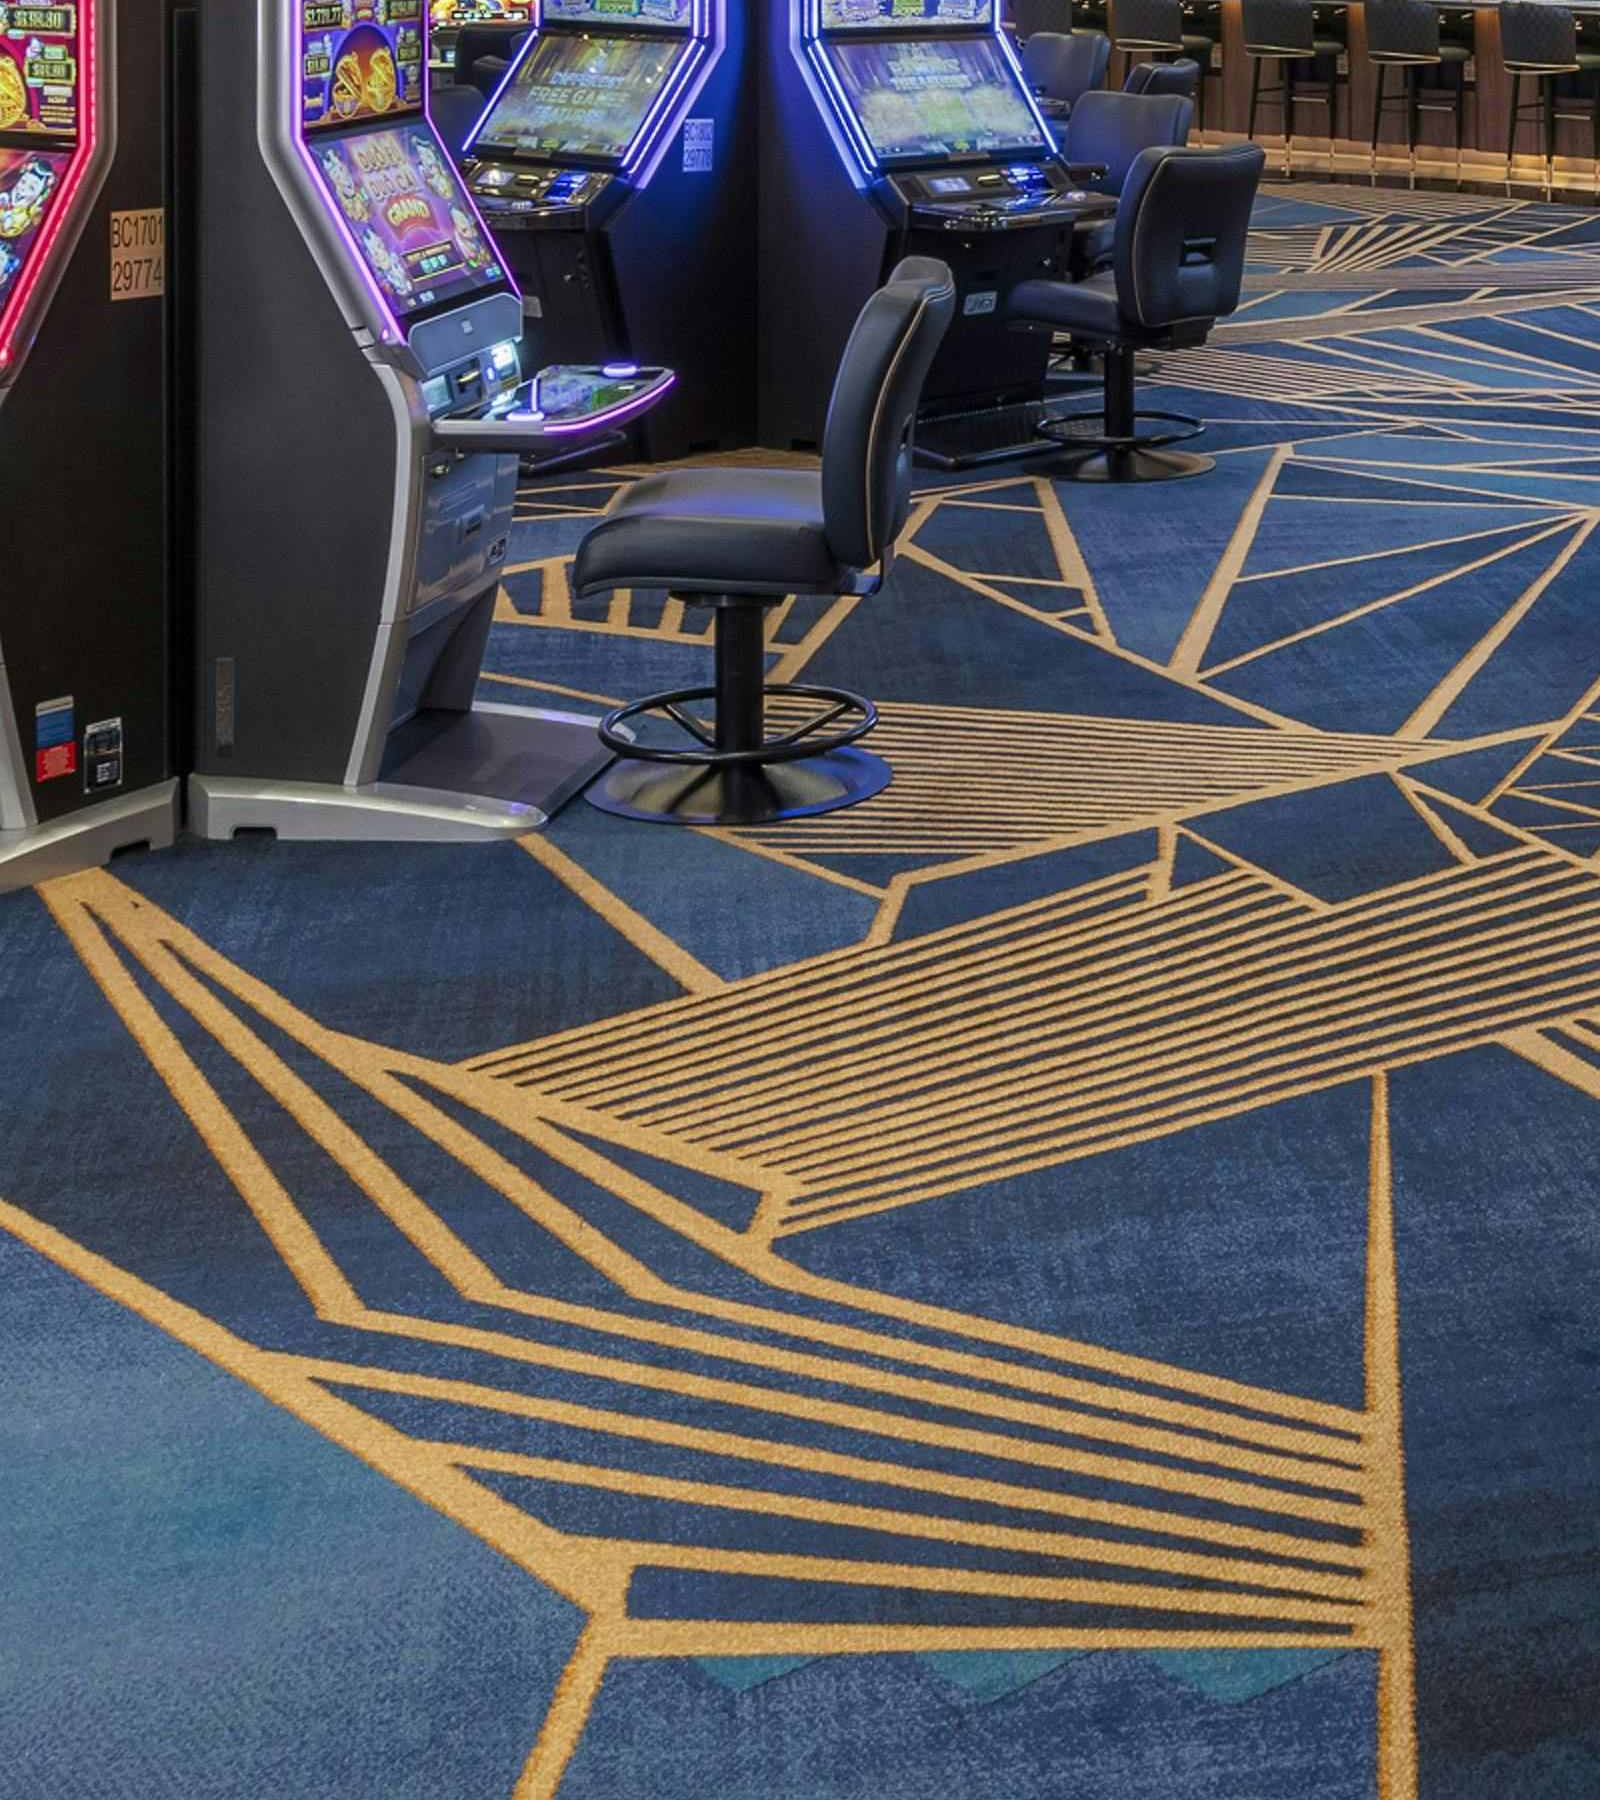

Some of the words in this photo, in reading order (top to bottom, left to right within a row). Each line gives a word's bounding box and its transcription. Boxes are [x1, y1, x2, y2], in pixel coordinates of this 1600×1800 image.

[528, 86, 569, 105] FREE
[112, 214, 164, 250] BC1701
[113, 257, 164, 293] 29774
